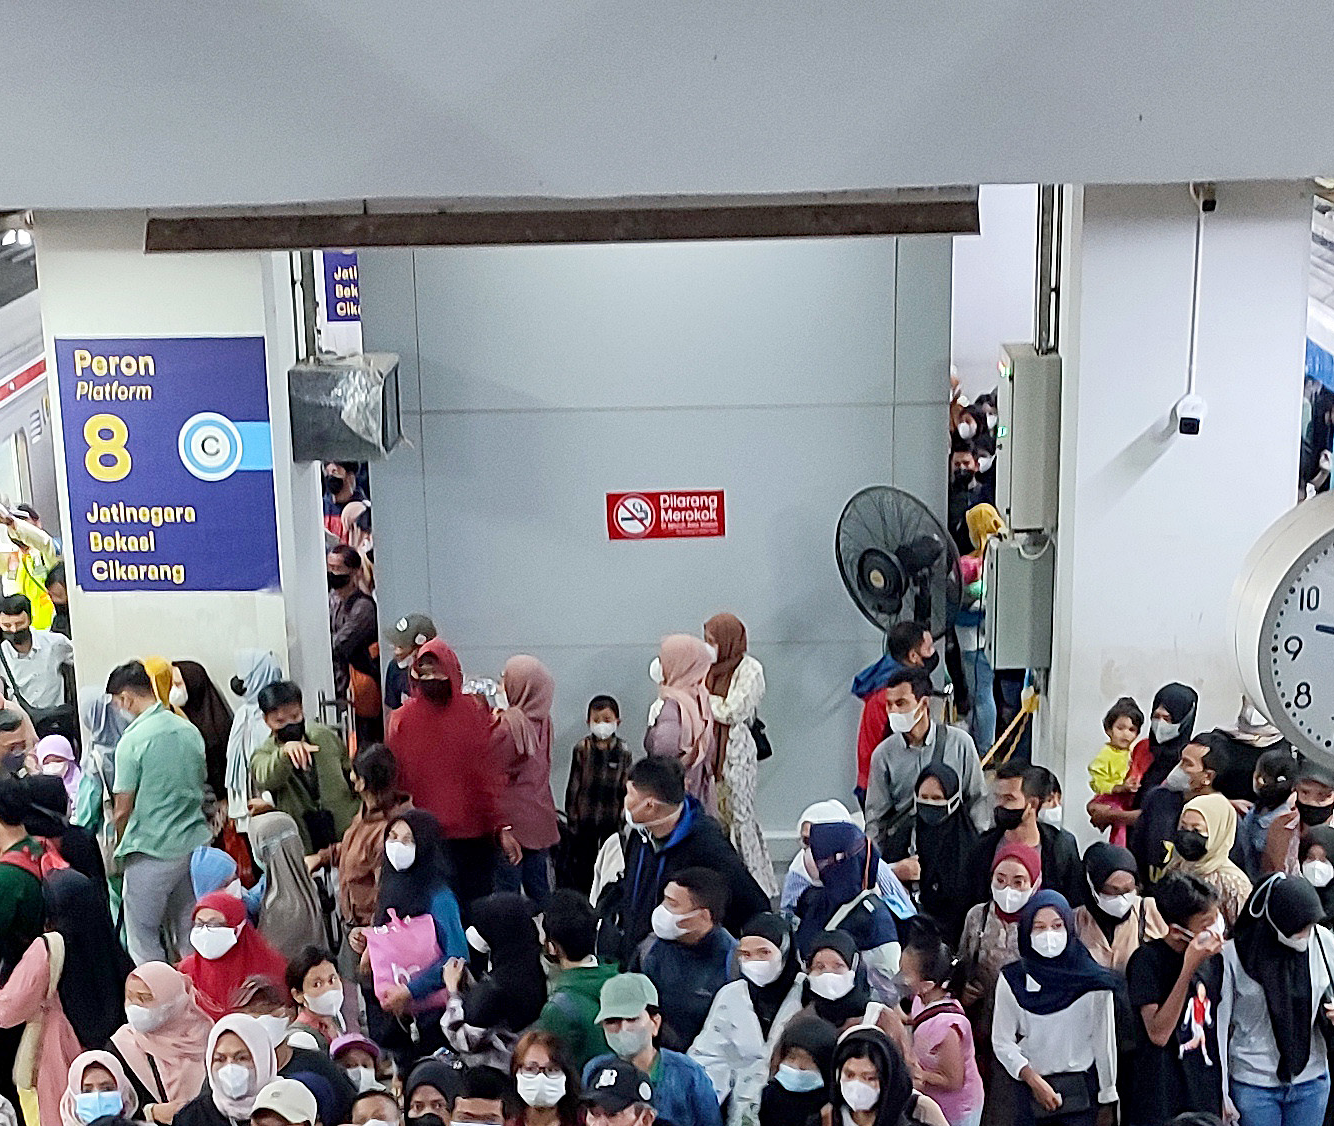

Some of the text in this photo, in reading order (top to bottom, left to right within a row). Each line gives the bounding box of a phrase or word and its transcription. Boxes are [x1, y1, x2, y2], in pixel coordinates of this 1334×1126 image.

[73, 349, 155, 377] Peron
[75, 380, 152, 402] Platform
[83, 413, 132, 483] 8
[200, 434, 221, 457] C
[86, 501, 196, 527] Jatinegara
[659, 494, 718, 508] Dilarang
[661, 508, 717, 522] Merokok
[89, 530, 155, 553] Bekasi
[91, 559, 185, 585] Cikarang
[1299, 585, 1320, 612] 10
[1283, 635, 1303, 662] 9
[1293, 681, 1312, 710] 8
